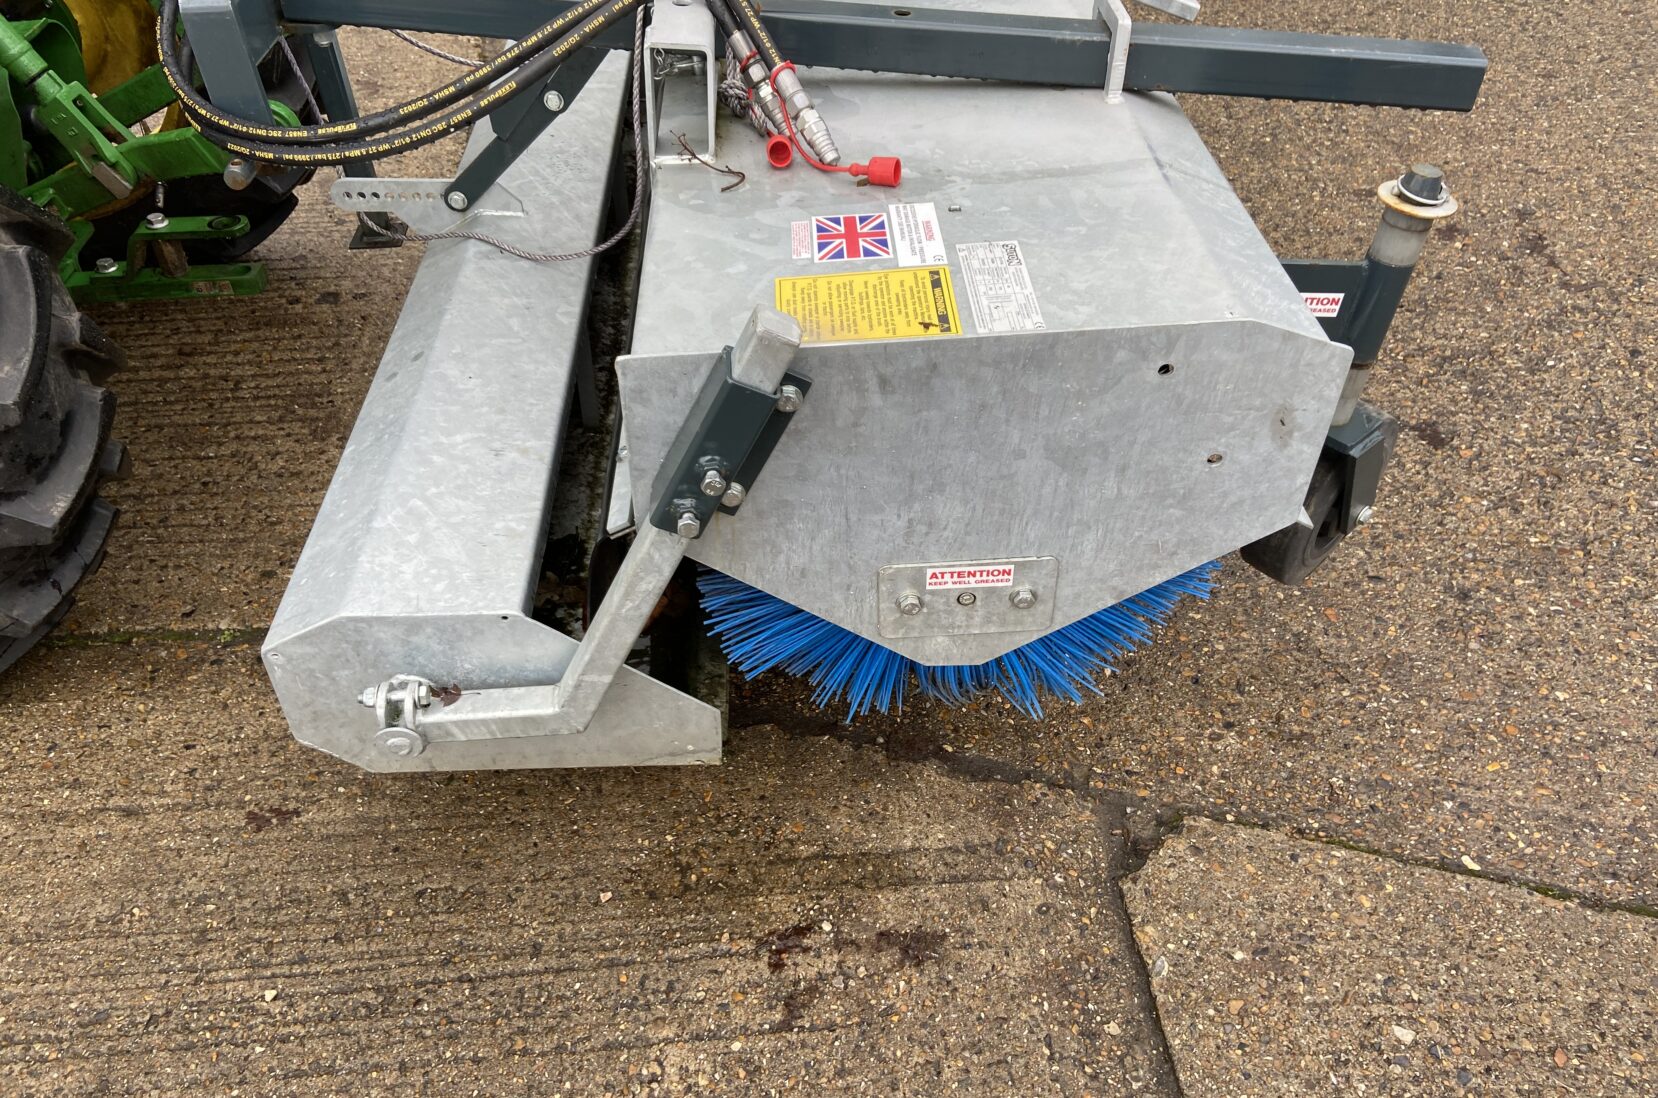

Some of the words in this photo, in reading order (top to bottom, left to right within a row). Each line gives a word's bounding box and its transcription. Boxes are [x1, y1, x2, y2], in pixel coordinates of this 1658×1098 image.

[552, 17, 565, 29] WP
[583, 15, 605, 33] MSHA
[750, 17, 761, 29] WP
[552, 33, 581, 57] 2Q/2023
[433, 85, 456, 100] MSHA
[248, 127, 267, 137] DN12
[412, 129, 432, 140] DN12
[255, 150, 274, 159] MSHA
[933, 287, 947, 315] WARNING
[929, 568, 1012, 580] ATTENTION
